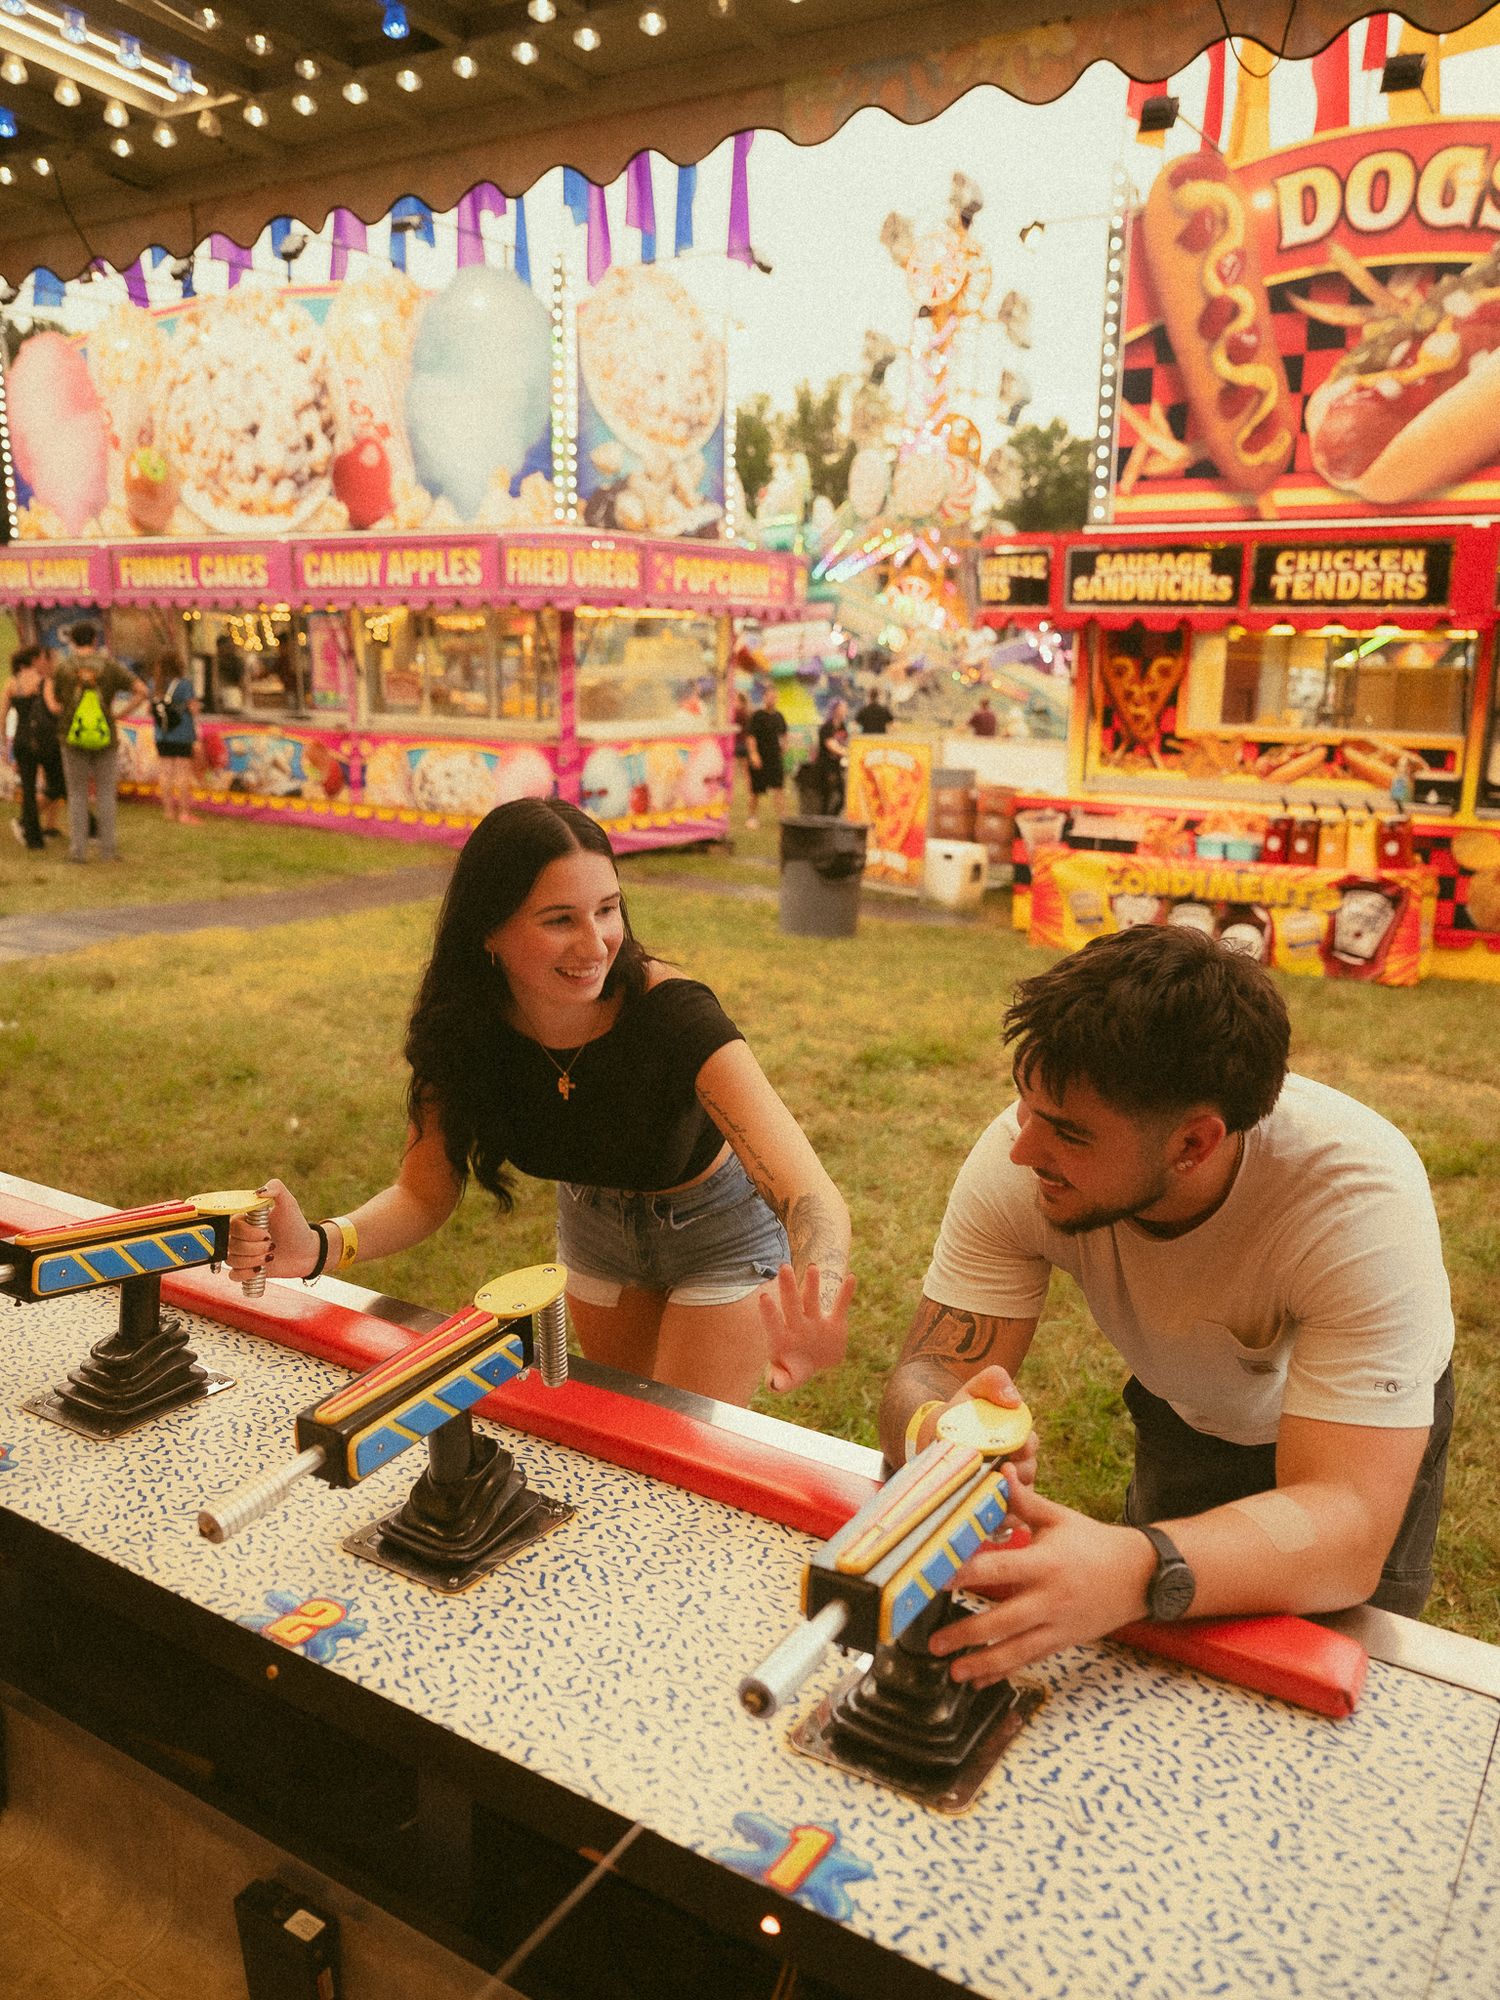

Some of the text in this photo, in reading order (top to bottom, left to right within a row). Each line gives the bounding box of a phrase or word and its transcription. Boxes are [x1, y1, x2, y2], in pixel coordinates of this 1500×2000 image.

[119, 554, 269, 588] FUNNEL CAKES
[303, 547, 483, 587] CANDY APPLES
[506, 549, 567, 586] FRIED
[1096, 552, 1212, 576] SAUSAGE
[1275, 549, 1426, 574] CHICKEN
[1073, 574, 1233, 601] SANDWICHES
[1270, 571, 1428, 600] TENDERS
[261, 1597, 346, 1648] 2
[763, 1825, 836, 1894] 1
